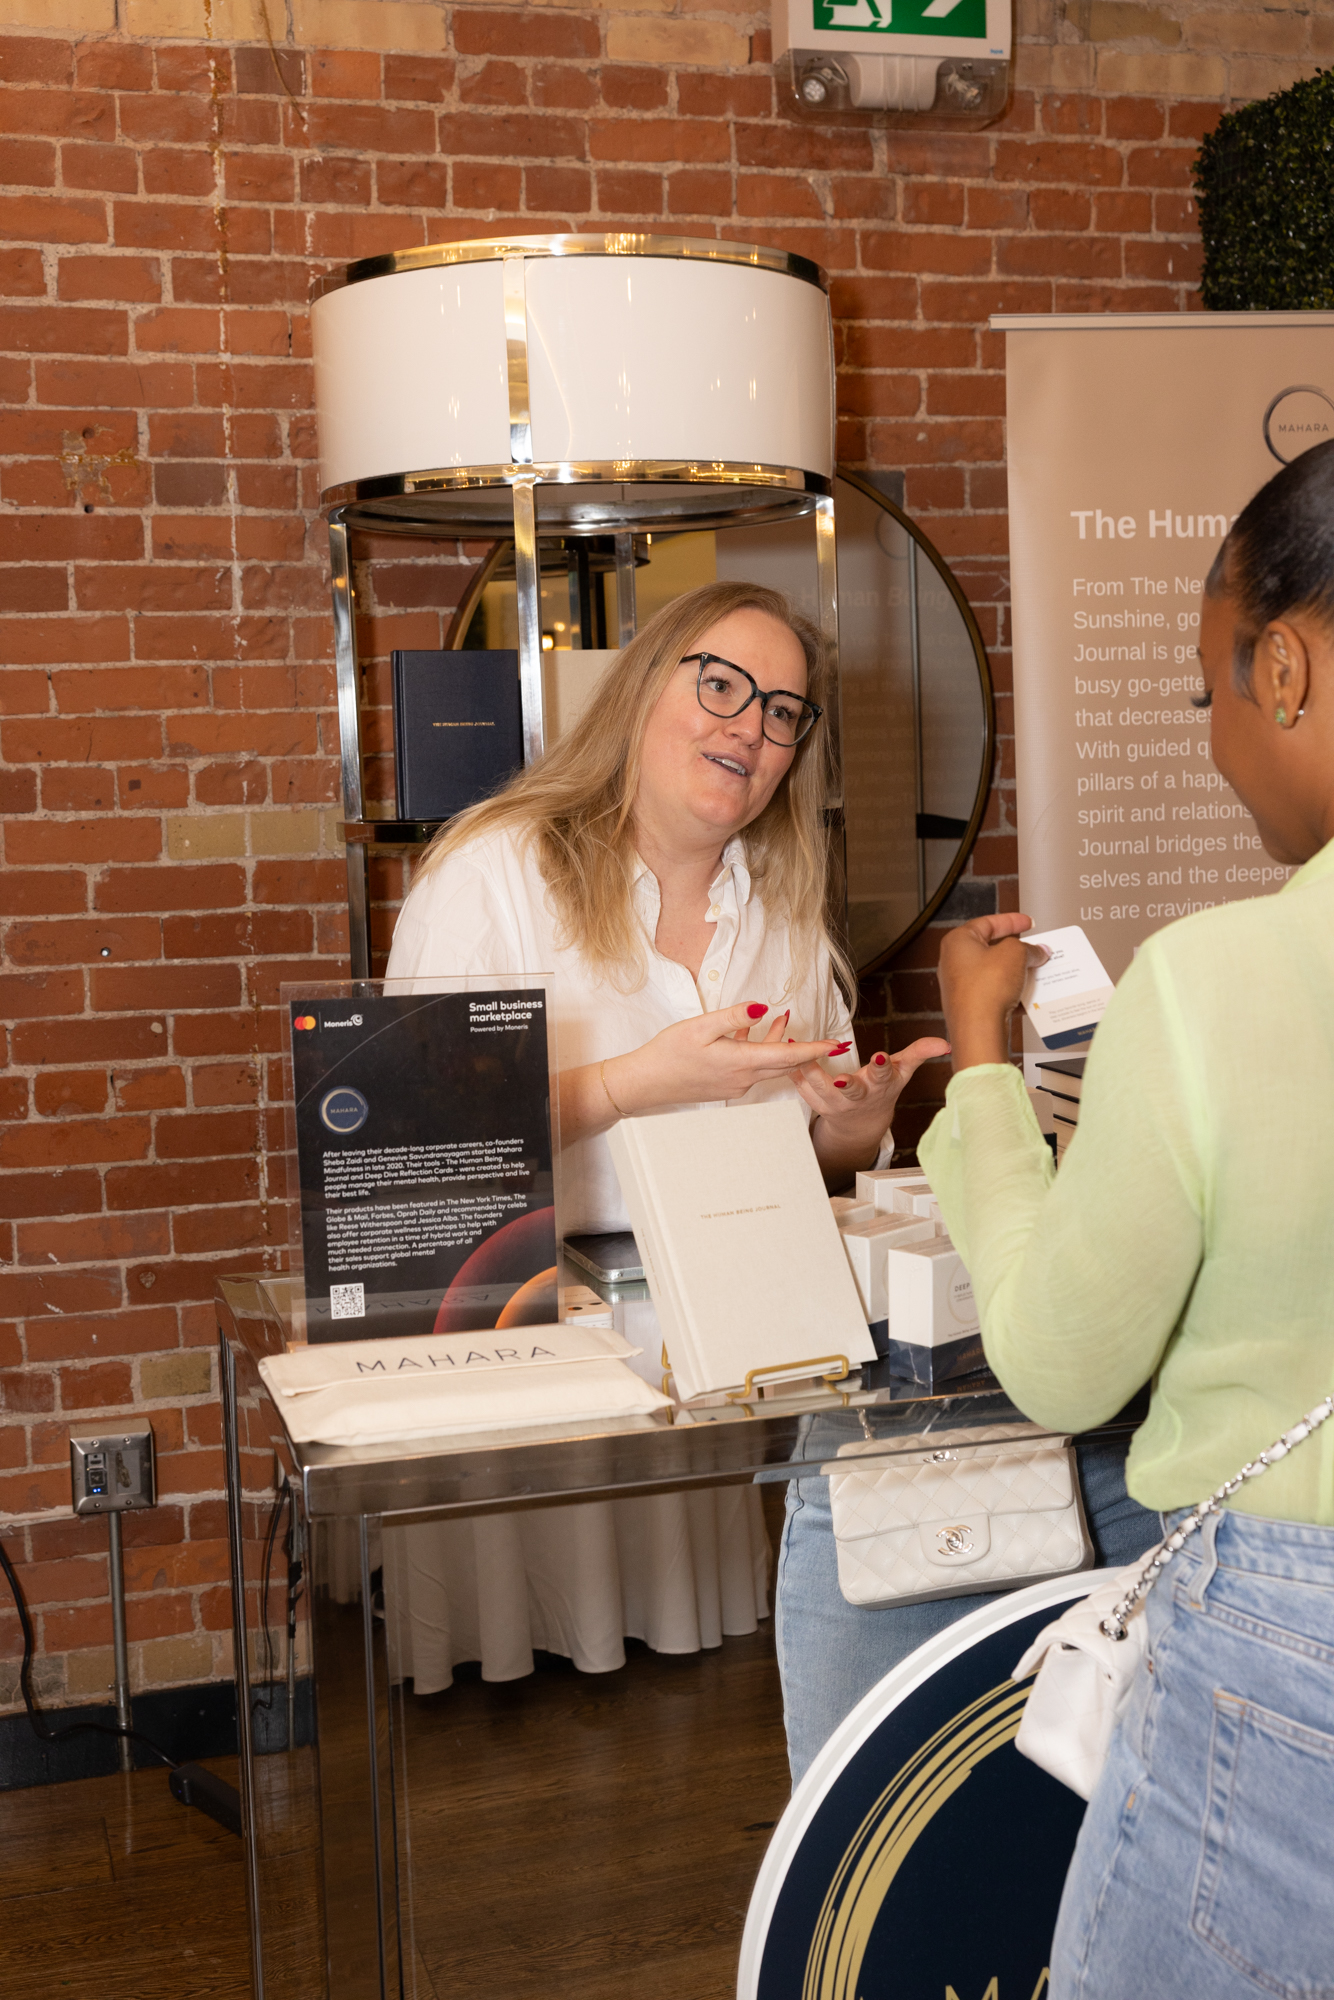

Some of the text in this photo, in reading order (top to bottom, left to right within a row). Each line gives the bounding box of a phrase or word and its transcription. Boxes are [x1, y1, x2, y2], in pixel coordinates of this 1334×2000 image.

[1278, 423, 1329, 433] MAHARA
[1070, 508, 1137, 540] The
[1073, 576, 1206, 597] From The Ne
[1073, 609, 1170, 630] Sunshine,
[1073, 641, 1198, 664] Journal is ge
[1075, 674, 1206, 698] busy go-gette
[1075, 708, 1113, 727] that
[1076, 740, 1121, 760] With
[1126, 738, 1191, 763] guided
[1077, 769, 1232, 797] pillars of a happ
[1077, 800, 1252, 828] spirit and relations
[1078, 832, 1263, 857] Journal bridges the
[1079, 869, 1141, 889] selves
[1147, 866, 1183, 886] and
[1188, 865, 1219, 885] the
[1225, 864, 1292, 886] deeper
[1080, 905, 1104, 921] us
[1109, 904, 1140, 920] are
[469, 1000, 543, 1012] Small business
[324, 1019, 353, 1028] Moneris
[469, 1012, 532, 1022] marketplace
[470, 1023, 529, 1033] Powered by Moneris
[341, 1149, 365, 1157] leaving
[383, 1145, 424, 1154] decade-long
[425, 1143, 457, 1152] corporate
[484, 1138, 525, 1146] co-founders
[323, 1158, 345, 1166] Sheba
[377, 1154, 407, 1162] Genevive
[323, 1165, 363, 1174] Mindfulness
[386, 1162, 404, 1170] 2020.
[484, 1155, 504, 1163] Being
[323, 1174, 349, 1182] Journal
[364, 1172, 382, 1180] Deep
[399, 1168, 432, 1176] Reflection
[476, 1163, 501, 1171] created
[510, 1161, 526, 1169] help
[324, 1183, 347, 1191] people
[393, 1177, 416, 1185] mental
[441, 1174, 465, 1182] provide
[466, 1171, 504, 1180] perspective
[343, 1205, 373, 1214] products
[409, 1200, 438, 1208] featured
[370, 1211, 395, 1219] Forbes,
[396, 1210, 417, 1218] Oprah
[418, 1208, 435, 1216] Daily
[450, 1204, 497, 1213] recommended
[506, 1201, 528, 1209] celebs
[338, 1222, 358, 1230] Reese
[359, 1219, 402, 1229] Witherspoon
[473, 1211, 503, 1219] founders
[359, 1228, 392, 1237] corporate
[393, 1226, 421, 1234] wellness
[422, 1223, 457, 1232] workshops
[466, 1221, 481, 1229] help
[327, 1239, 359, 1248] employee
[359, 1236, 390, 1244] retention
[429, 1231, 450, 1240] hybrid
[372, 1243, 410, 1251] connection.
[418, 1239, 455, 1249] percentage
[350, 1260, 398, 1270] organizations.
[363, 1252, 389, 1261] support
[390, 1251, 411, 1259] global
[954, 1282, 971, 1292] DEEP
[355, 1346, 557, 1373] MAHARA
